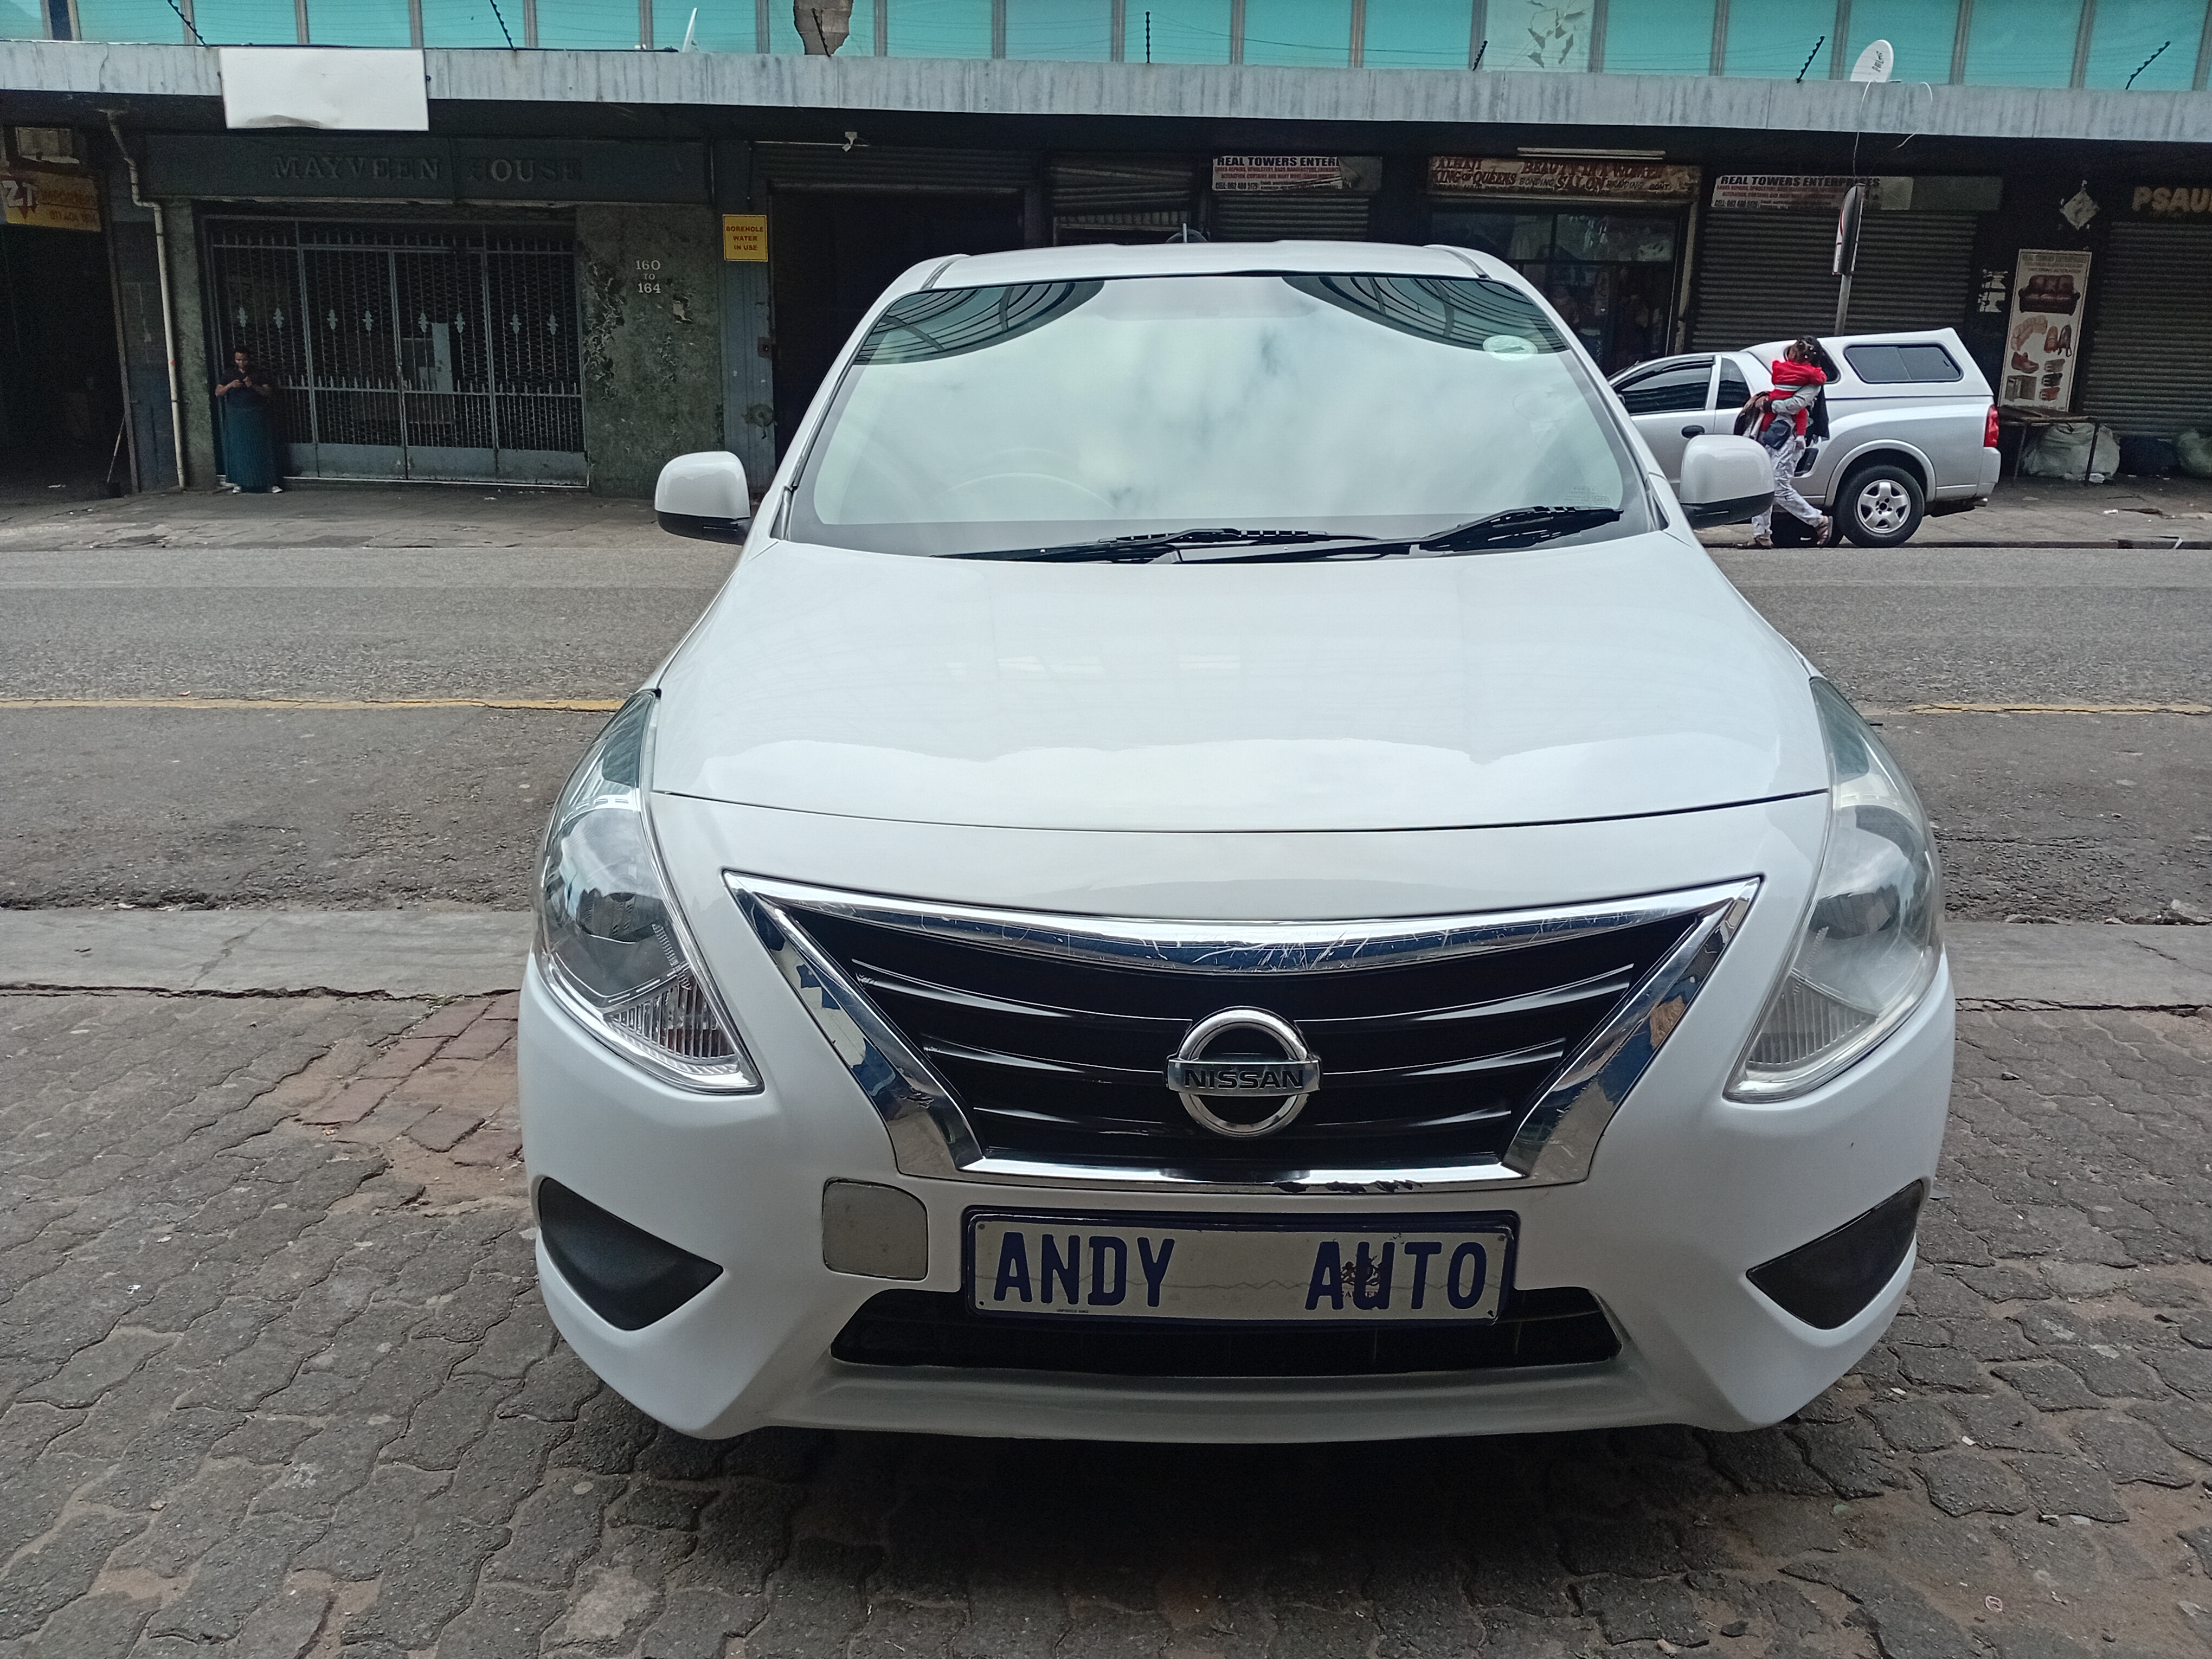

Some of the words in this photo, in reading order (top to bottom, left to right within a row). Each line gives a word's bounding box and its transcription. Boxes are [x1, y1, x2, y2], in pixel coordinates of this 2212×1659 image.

[273, 156, 438, 179] MAYVEEN
[1218, 157, 1244, 166] REAL
[1248, 157, 1297, 166] TOWERS
[1721, 176, 1748, 185] REAL
[1752, 176, 1801, 187] TOWERS
[2132, 186, 2212, 213] PSAU
[635, 260, 661, 270] 160
[638, 282, 661, 293] 164
[1184, 1069, 1303, 1089] NISSAN
[992, 1231, 1175, 1307] ANDY
[1304, 1239, 1488, 1311] AUTO
